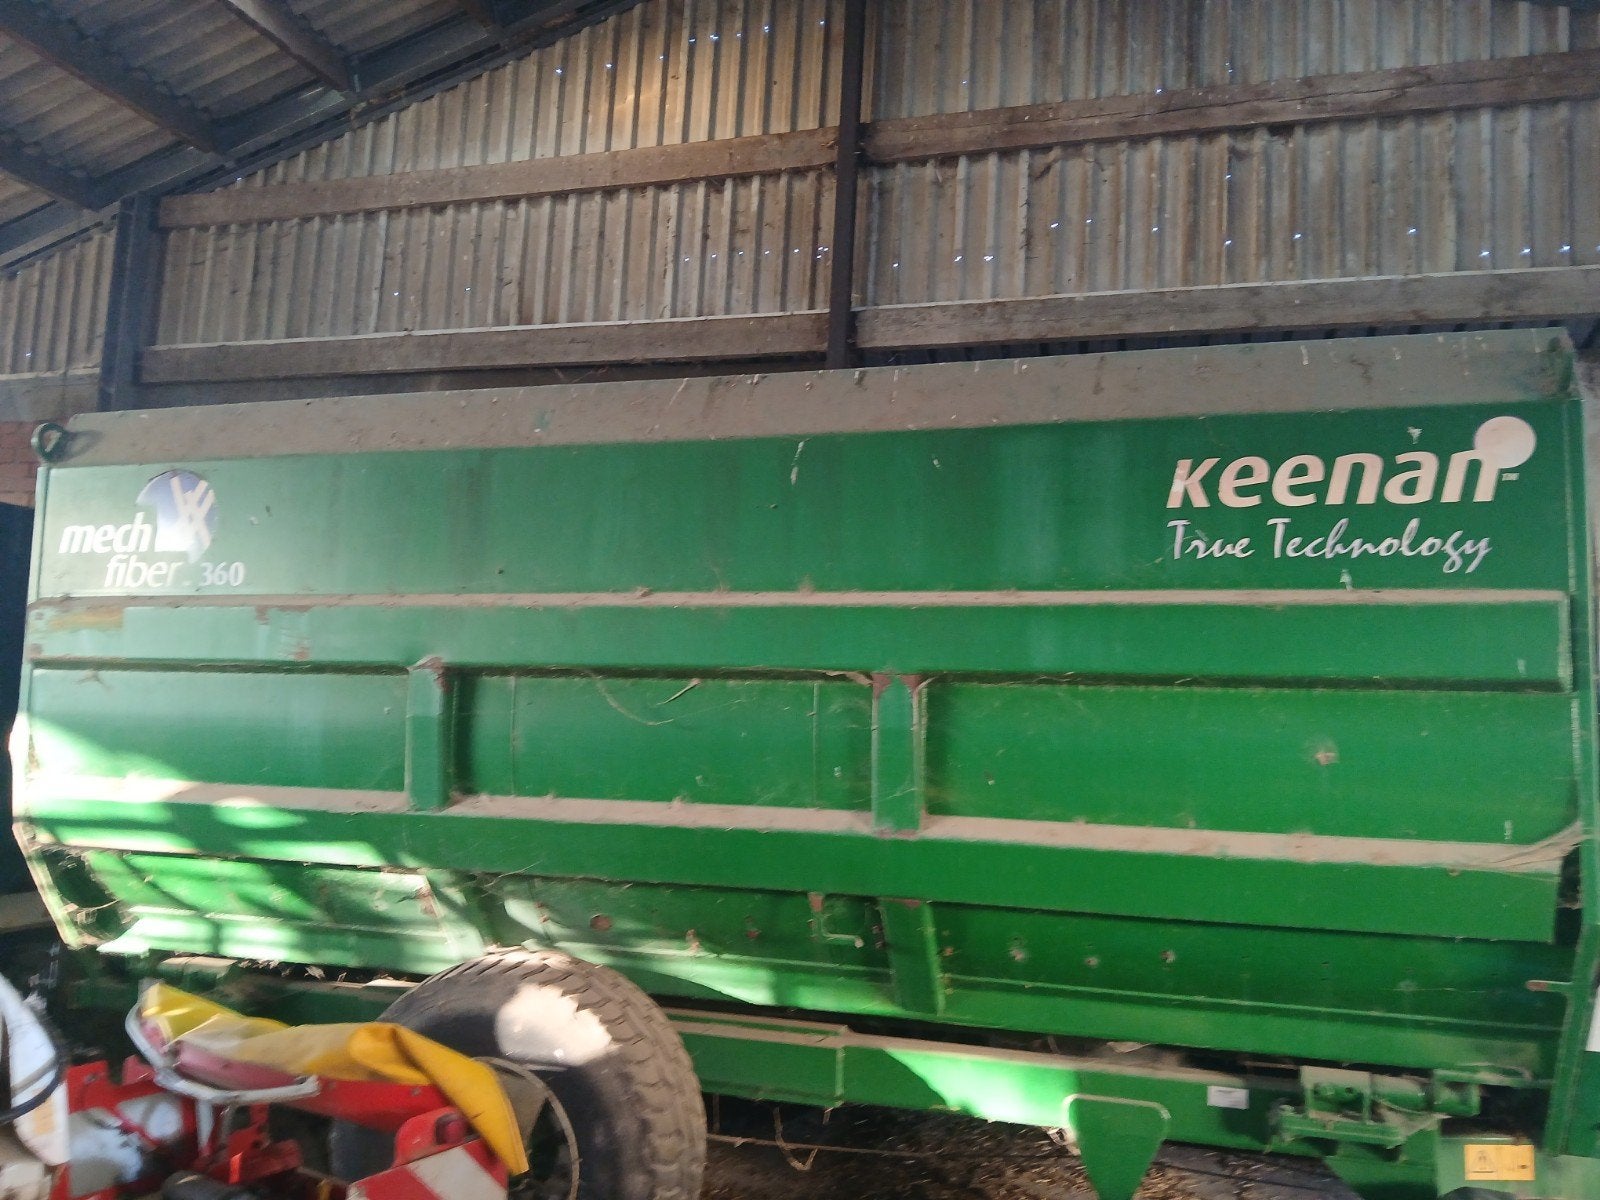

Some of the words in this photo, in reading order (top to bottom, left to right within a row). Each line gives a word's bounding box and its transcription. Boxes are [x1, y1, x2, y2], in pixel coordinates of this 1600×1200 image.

[58, 511, 153, 554] mech
[1166, 518, 1255, 560] True
[1266, 517, 1492, 574] Technology
[103, 554, 185, 588] fiber
[200, 561, 246, 587] 360
